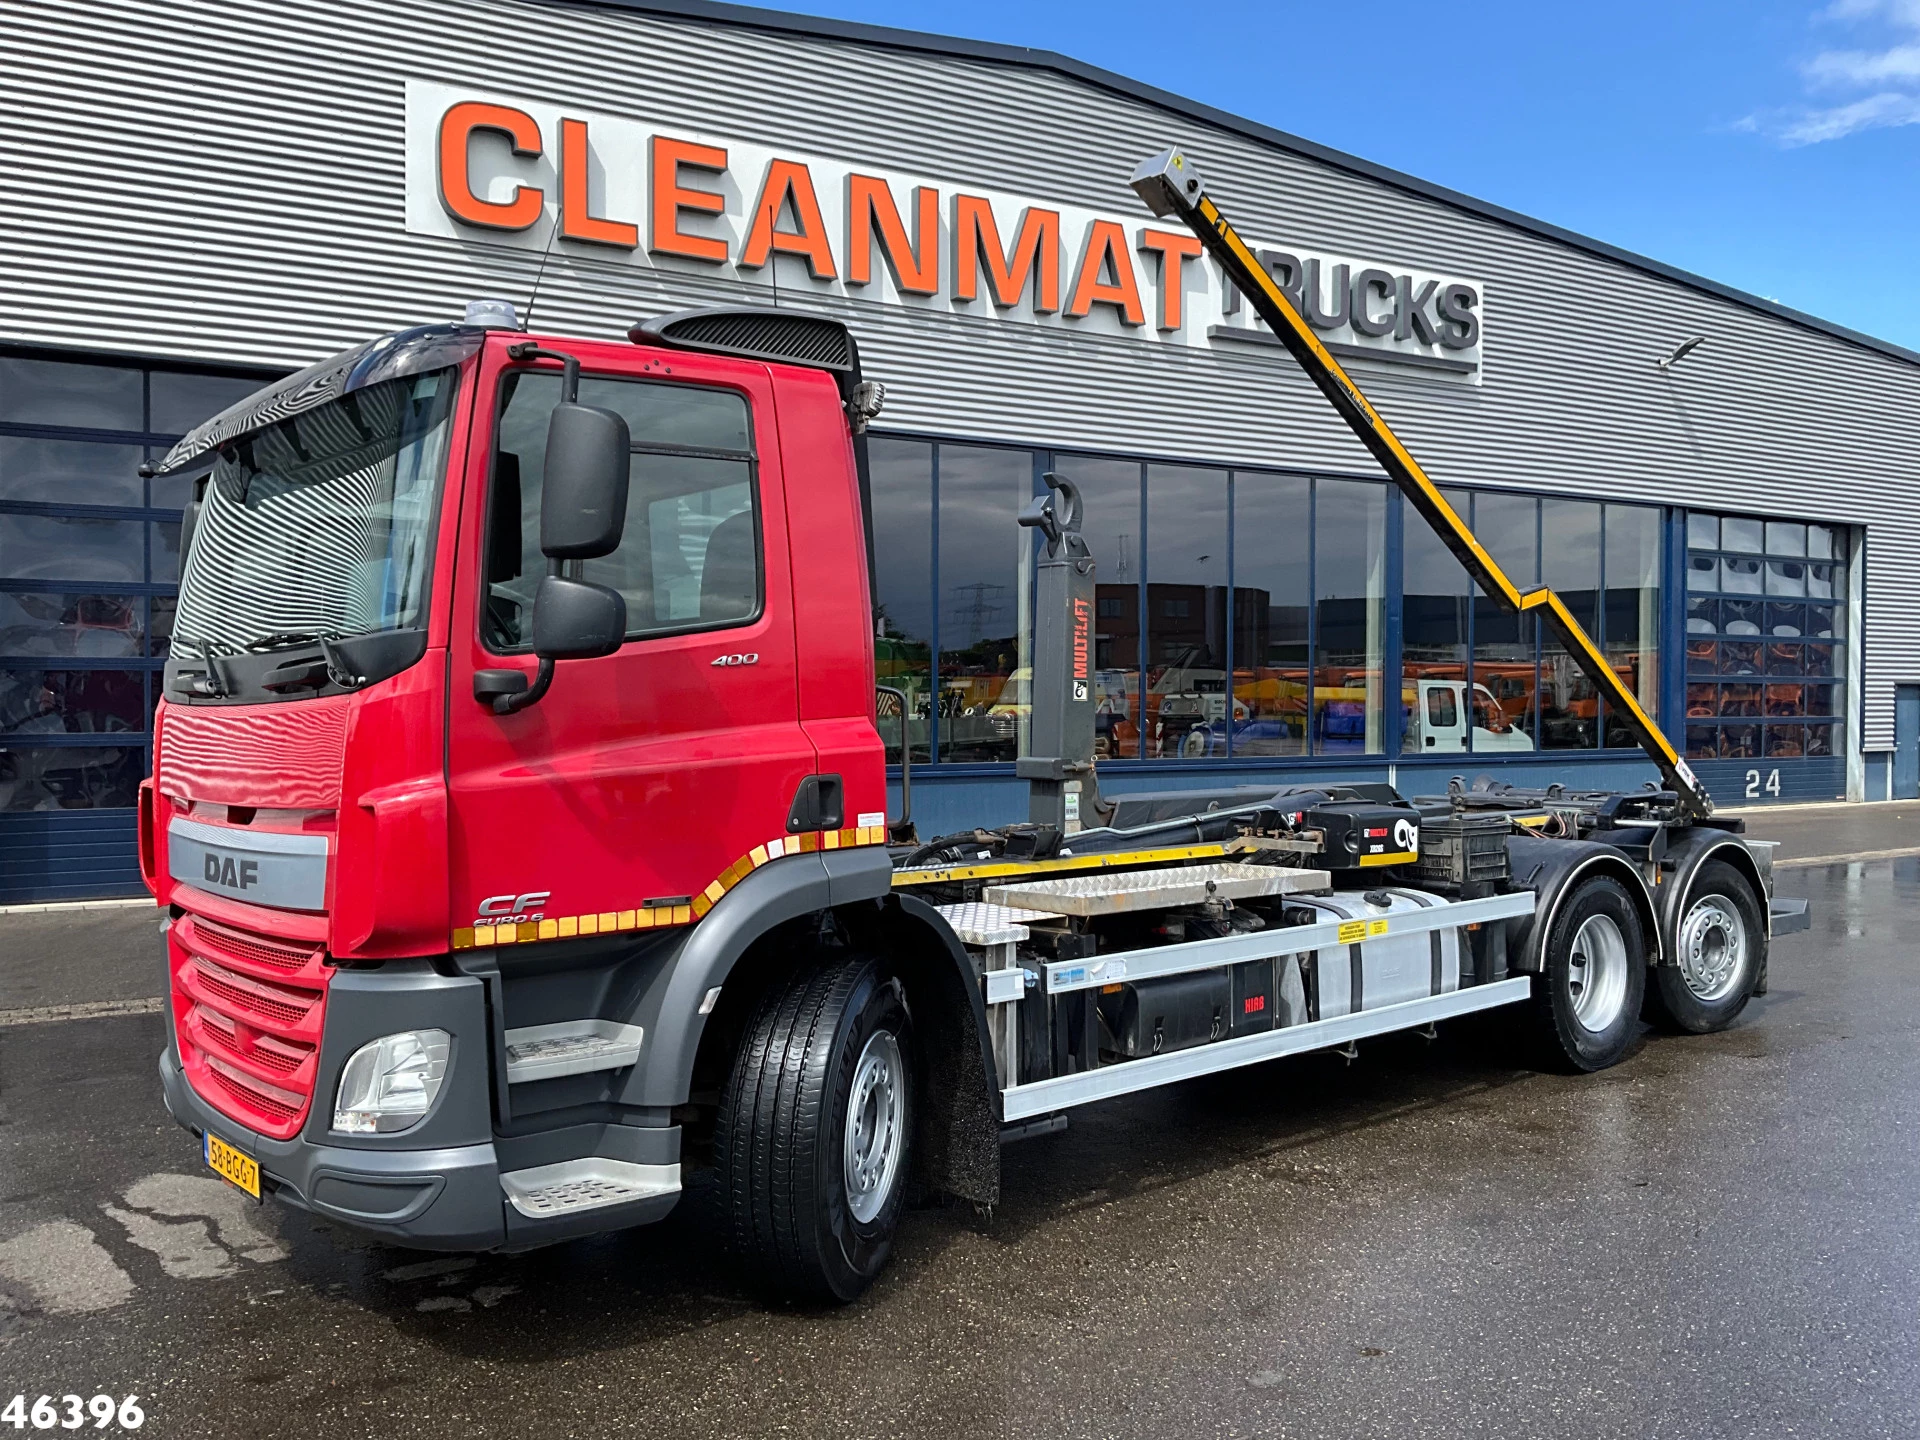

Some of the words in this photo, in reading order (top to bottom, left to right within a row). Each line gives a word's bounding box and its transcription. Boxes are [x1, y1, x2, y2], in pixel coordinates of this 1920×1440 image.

[438, 100, 1202, 332] CLEANMAT
[1073, 597, 1088, 679] MULTILIFT
[710, 653, 759, 667] 400
[1745, 768, 1781, 798] 24
[204, 852, 258, 890] DAF
[478, 891, 551, 916] CF
[473, 914, 528, 928] EURO
[530, 912, 544, 922] 6
[1245, 995, 1265, 1014] HIAB
[211, 1140, 257, 1189] 58-BGG-7
